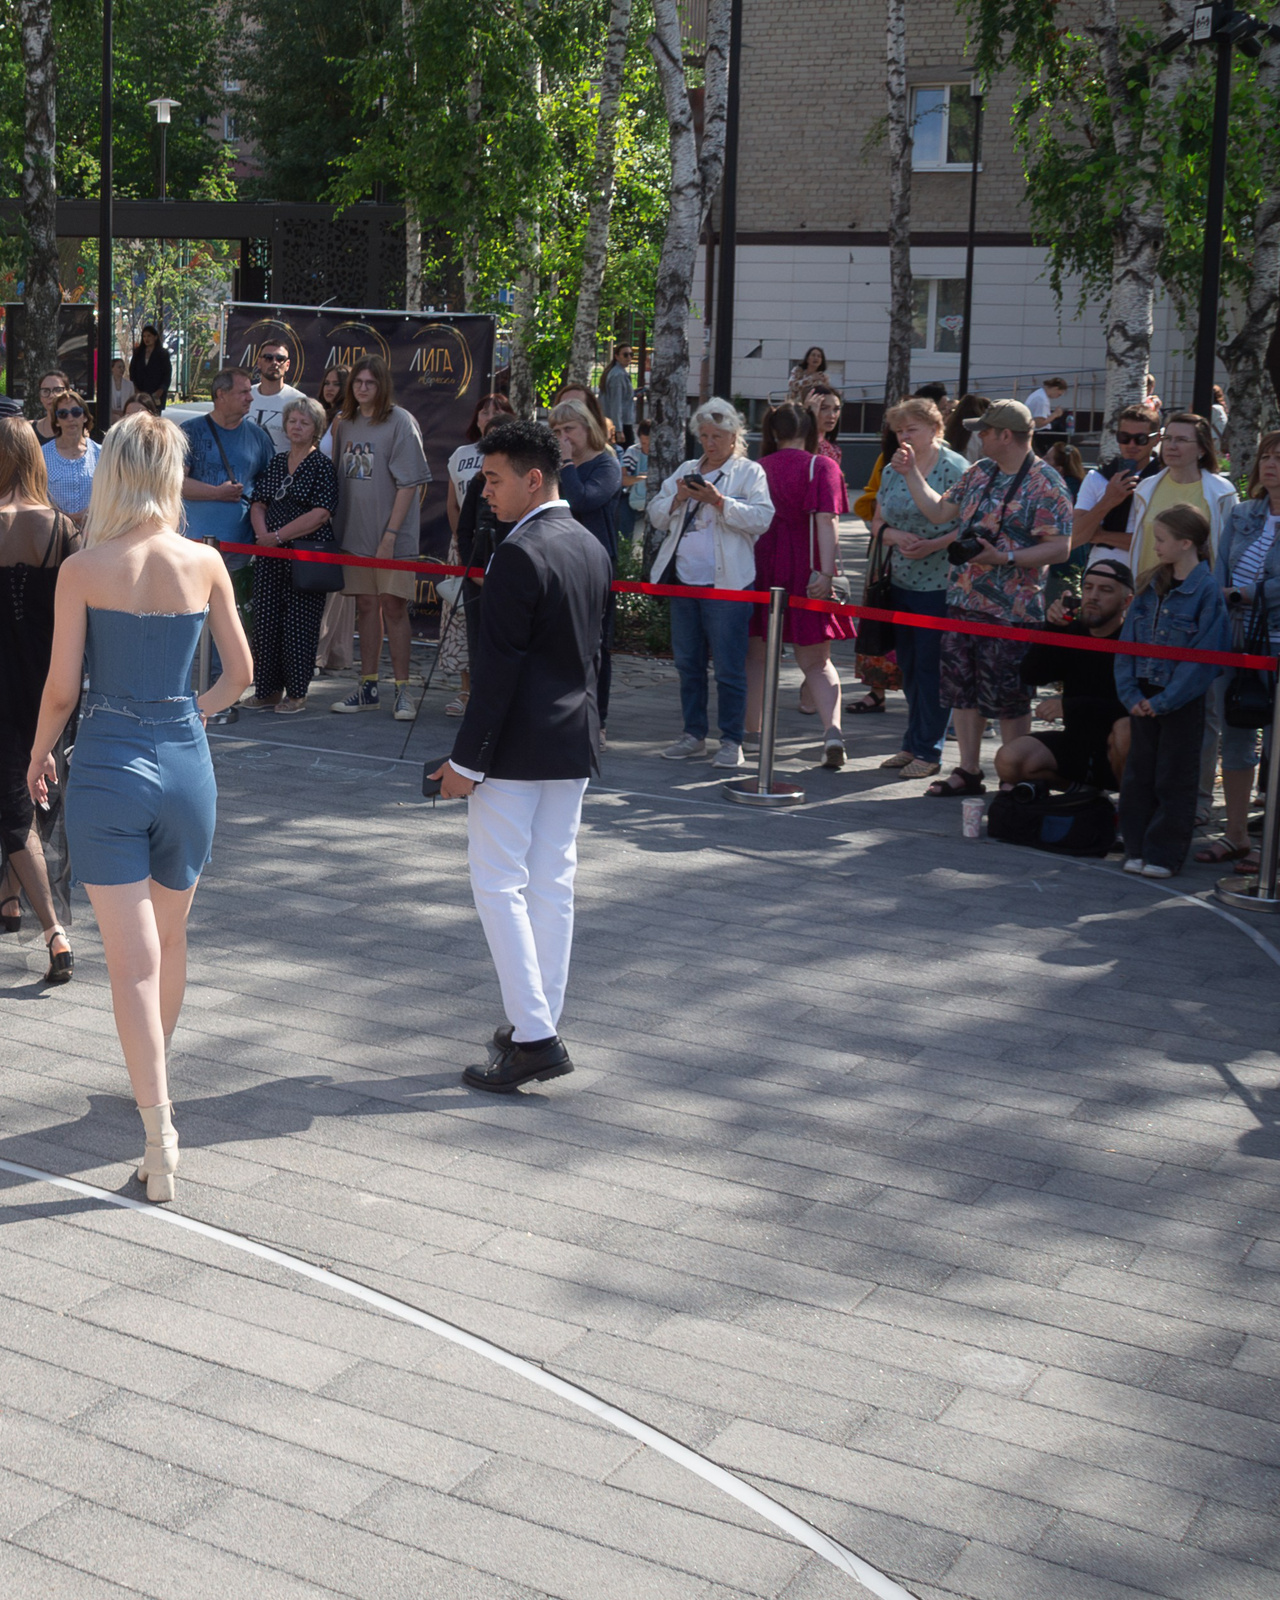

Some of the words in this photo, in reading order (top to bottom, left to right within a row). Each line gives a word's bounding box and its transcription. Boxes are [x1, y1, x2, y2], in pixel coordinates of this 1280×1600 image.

[238, 343, 262, 367] ЛИ
[409, 347, 454, 372] ЛИГА
[457, 455, 483, 472] ORL
[415, 580, 438, 604] ГА
